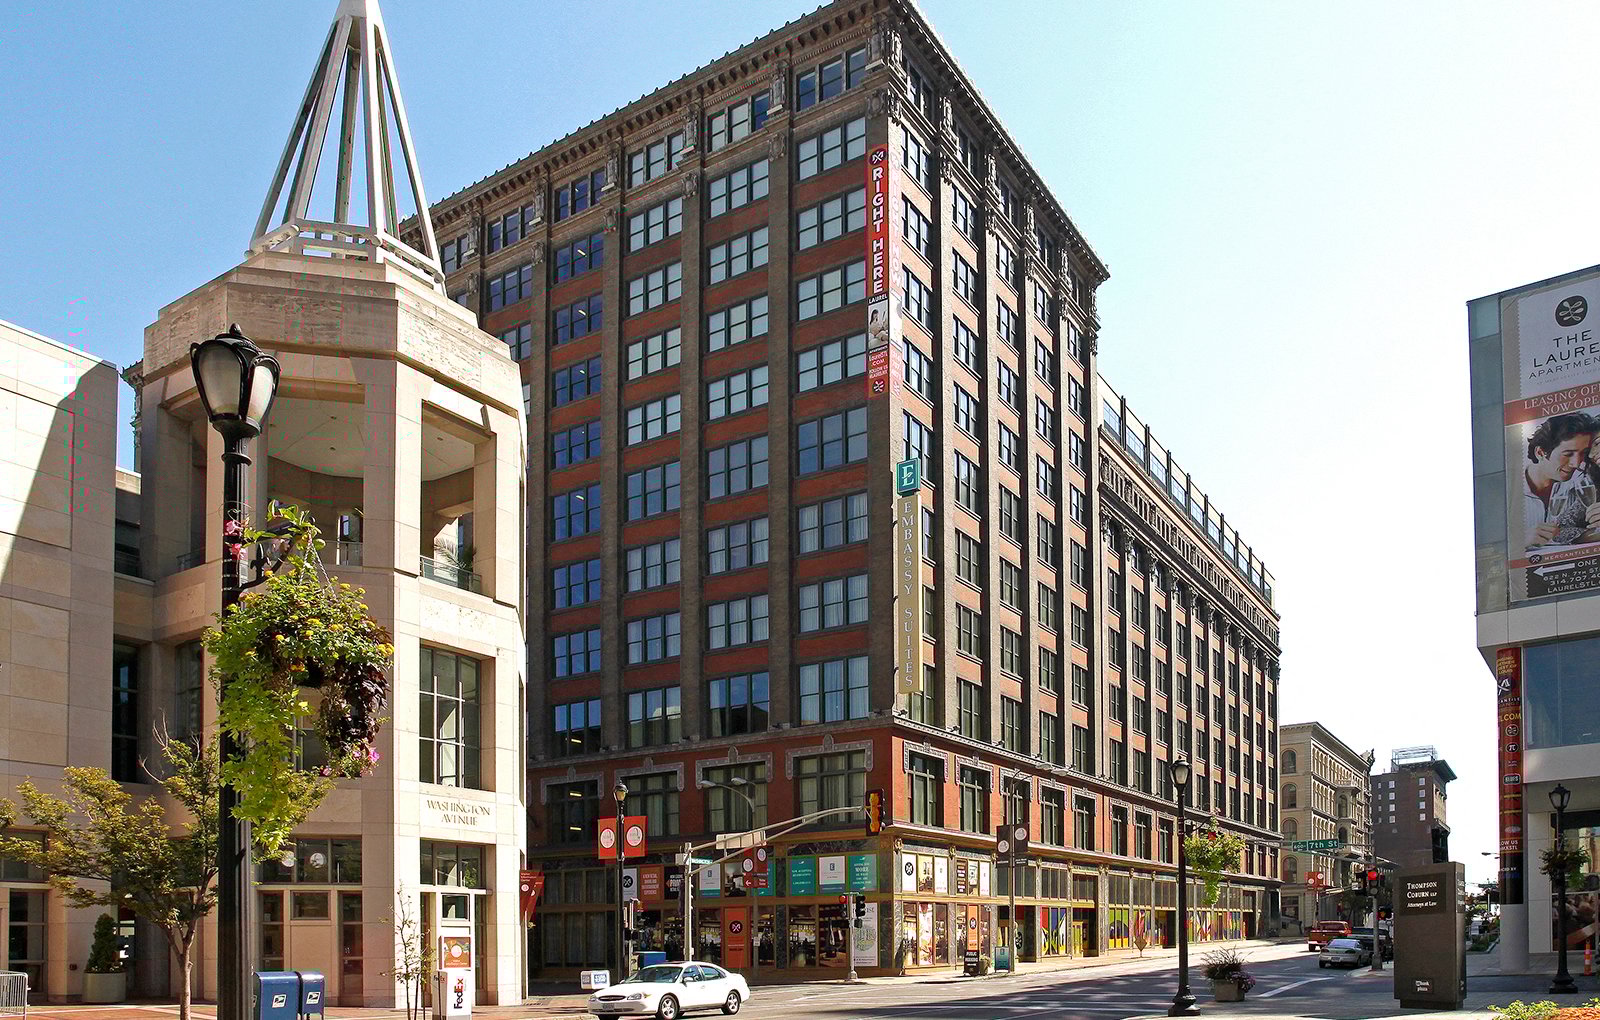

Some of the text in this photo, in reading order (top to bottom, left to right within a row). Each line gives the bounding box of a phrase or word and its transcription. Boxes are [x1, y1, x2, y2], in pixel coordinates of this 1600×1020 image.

[872, 166, 884, 294] RIGHT HERE
[868, 293, 888, 304] LAUREL
[1553, 329, 1592, 348] THE
[1533, 342, 1600, 368] LAURE
[1524, 383, 1600, 410] LEASING OF
[1542, 395, 1600, 417] NOW OPE
[1544, 549, 1590, 561] MERCANTILE
[1577, 558, 1598, 568] ONE
[901, 501, 915, 688] EMBASSY SUITES
[1547, 580, 1600, 594] LAURELSTL.
[427, 799, 491, 816] WASHINGTON
[441, 813, 478, 826] AVENUE
[1328, 840, 1338, 848] St
[453, 978, 464, 1009] FedEx
